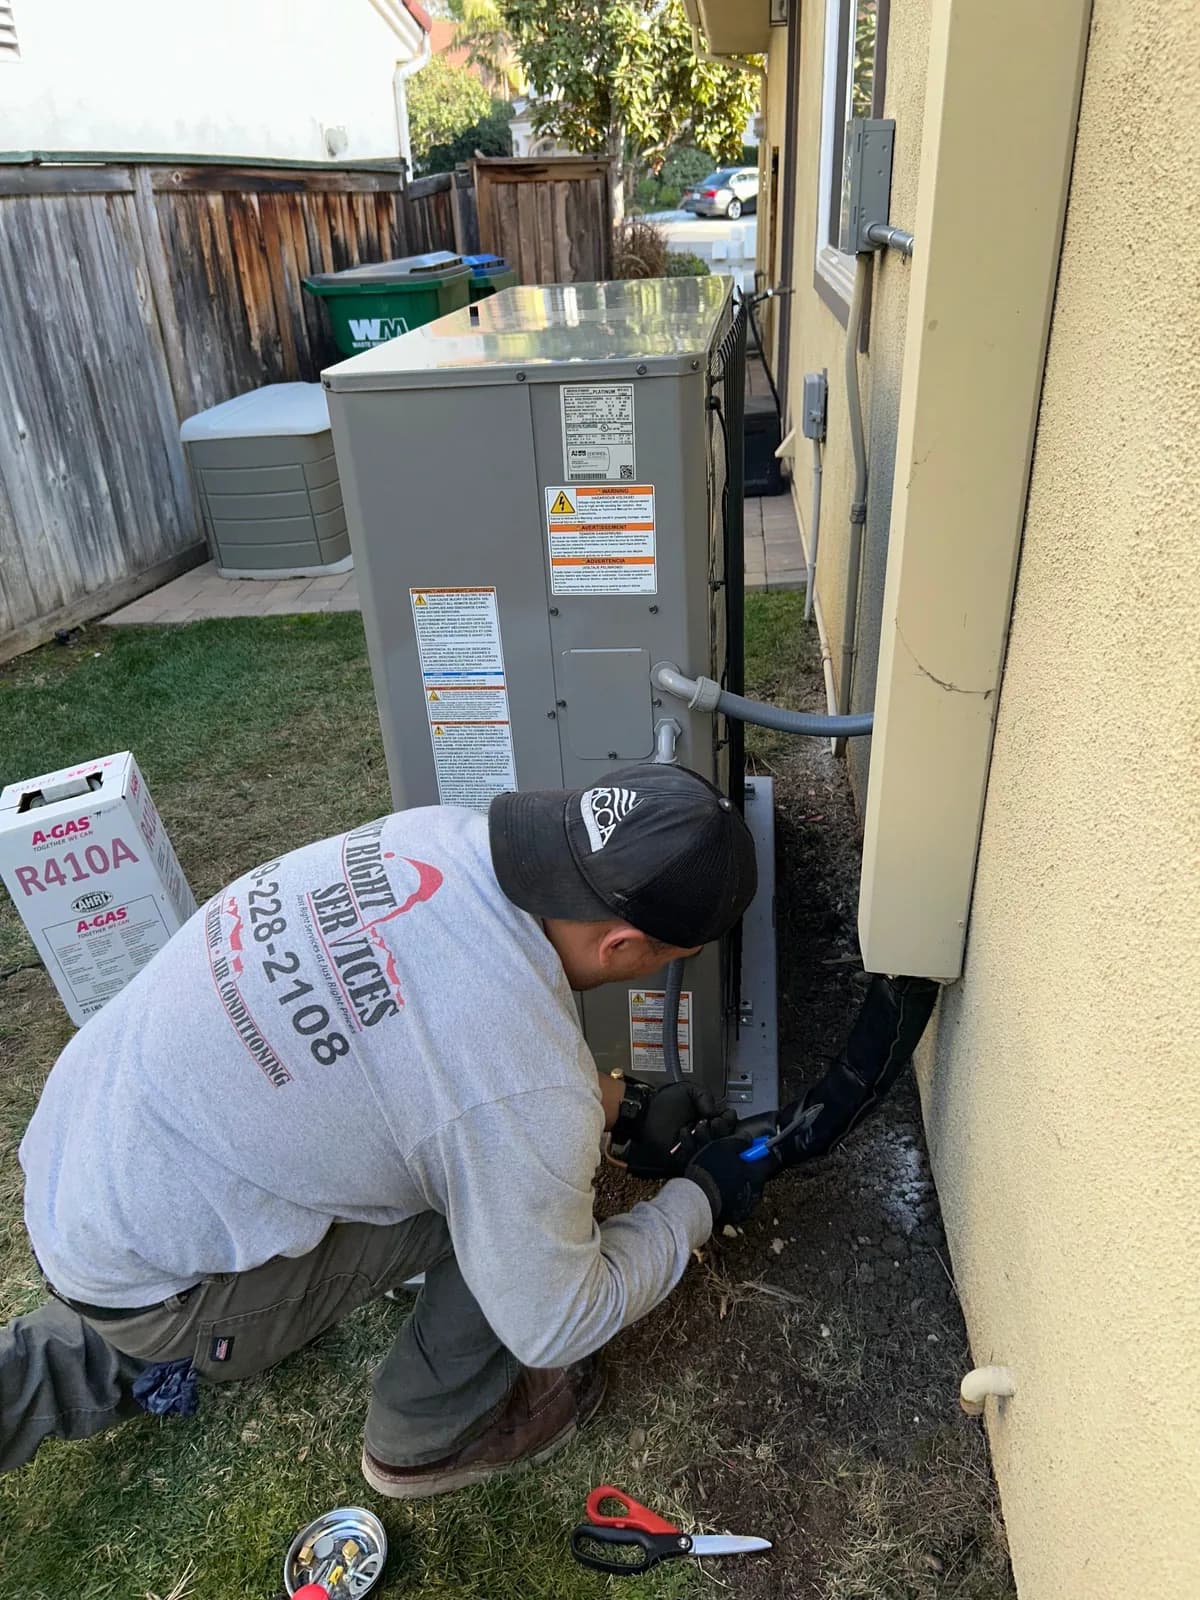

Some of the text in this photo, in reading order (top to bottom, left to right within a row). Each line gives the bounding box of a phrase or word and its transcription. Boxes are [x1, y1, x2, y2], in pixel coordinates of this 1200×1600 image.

[348, 317, 409, 341] WM
[31, 816, 90, 846] A-GAS
[33, 838, 67, 853] TOGETHER
[81, 831, 94, 839] CAN
[14, 837, 140, 897] R410A
[346, 841, 398, 911] RIGHT
[77, 893, 107, 911] AHRI
[299, 906, 312, 925] Right
[76, 906, 127, 933] A-GAS
[78, 927, 106, 939] TOGETHER
[208, 905, 223, 949] HEATING
[304, 923, 322, 954] Services
[248, 862, 350, 1066] 9-228-2108
[311, 882, 400, 1027] SERVICES
[315, 953, 325, 964] at
[212, 956, 230, 983] AIR
[320, 963, 332, 981] Just
[328, 981, 344, 1006] Right
[340, 1006, 357, 1035] Prices
[221, 980, 291, 1089] CONDITIONING
